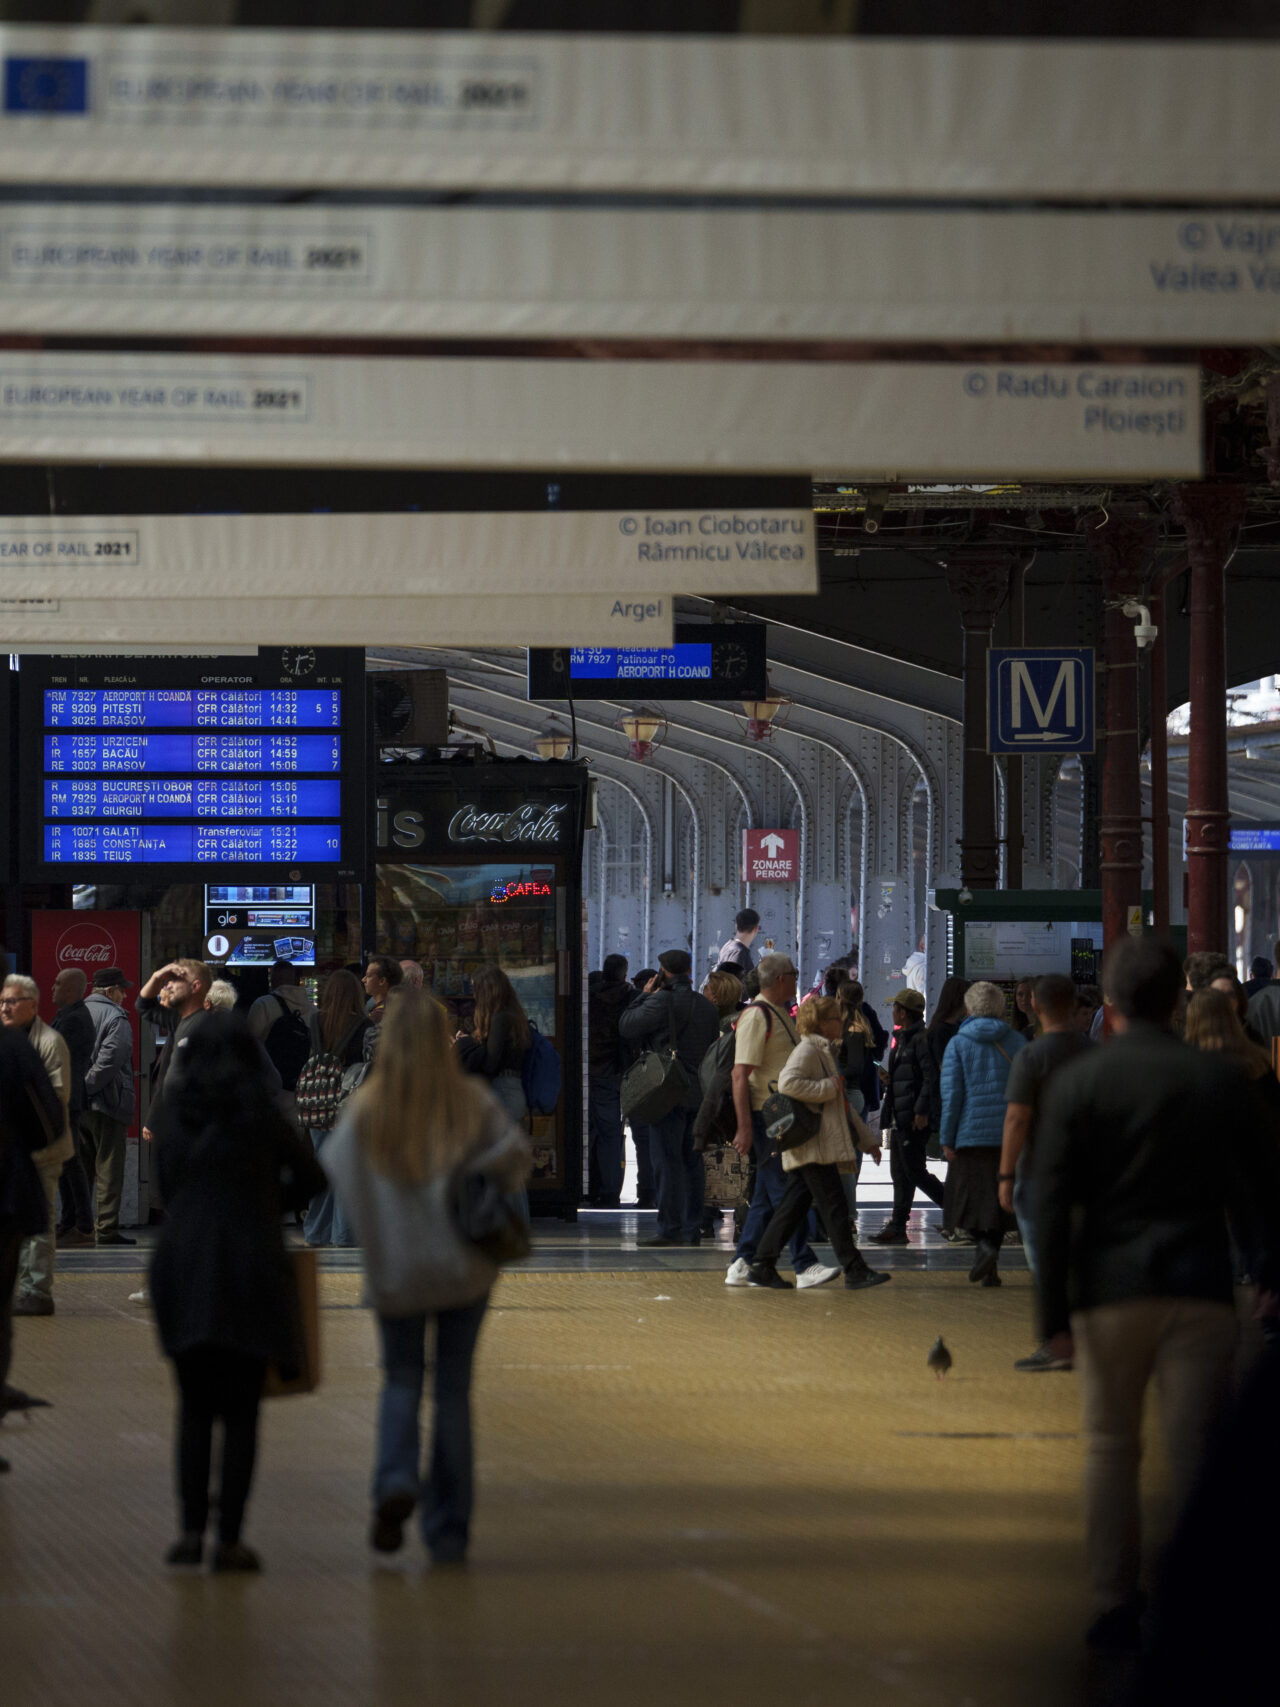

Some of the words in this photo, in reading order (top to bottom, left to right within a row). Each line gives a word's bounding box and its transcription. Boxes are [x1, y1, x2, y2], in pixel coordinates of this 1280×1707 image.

[996, 371, 1069, 397] Radu
[1077, 372, 1184, 397] Caraion
[4, 386, 115, 407] EUROPEAN
[118, 387, 166, 407] YEAR
[173, 388, 199, 407] OF
[253, 388, 302, 408] 2021
[645, 517, 692, 535] Ioan
[698, 515, 804, 535] Ciobotaru
[34, 542, 53, 557] OF
[57, 542, 91, 557] RAIL
[94, 542, 132, 557] 2021
[637, 541, 730, 561] Râmnicu
[735, 540, 804, 561] Vâlcea
[610, 599, 662, 622] Argel
[570, 655, 585, 664] RM
[587, 655, 611, 664] 7927
[616, 655, 658, 664] Patinoar
[660, 655, 675, 664] PO
[617, 666, 666, 678] AEROPORT
[668, 666, 676, 678] H
[677, 666, 711, 678] COAND
[72, 691, 96, 701] 7927
[103, 691, 146, 701] AEROPORT
[1009, 659, 1077, 729] M
[71, 703, 97, 713] 9209
[270, 703, 297, 713] 14:32
[72, 716, 97, 725] 3025
[270, 715, 297, 725] 14:44
[72, 736, 96, 747] 7035
[103, 737, 148, 746] URZICENI
[270, 737, 297, 747] 14:52
[72, 749, 96, 758] 1657
[270, 749, 297, 758] 14:59
[72, 760, 96, 770] 3003
[163, 782, 192, 791] OBOR
[72, 793, 97, 803] 7929
[103, 793, 146, 803] AEROPORT
[271, 793, 297, 804] 15:10
[72, 805, 96, 815] 9347
[102, 806, 142, 816] GIURGIU
[270, 806, 297, 815] 15:14
[376, 798, 426, 848] is
[447, 802, 568, 844] Coca-Cola
[198, 827, 263, 836] Transferoviar
[271, 827, 296, 837] 15:21
[270, 839, 297, 848] 15:22
[72, 851, 97, 860] 1835
[270, 851, 297, 861] 15:27
[752, 860, 793, 870] ZONARE
[755, 870, 789, 878] PERON
[506, 881, 551, 897] CAFEA
[217, 910, 237, 927] glo
[58, 943, 114, 962] Coca-Cola
